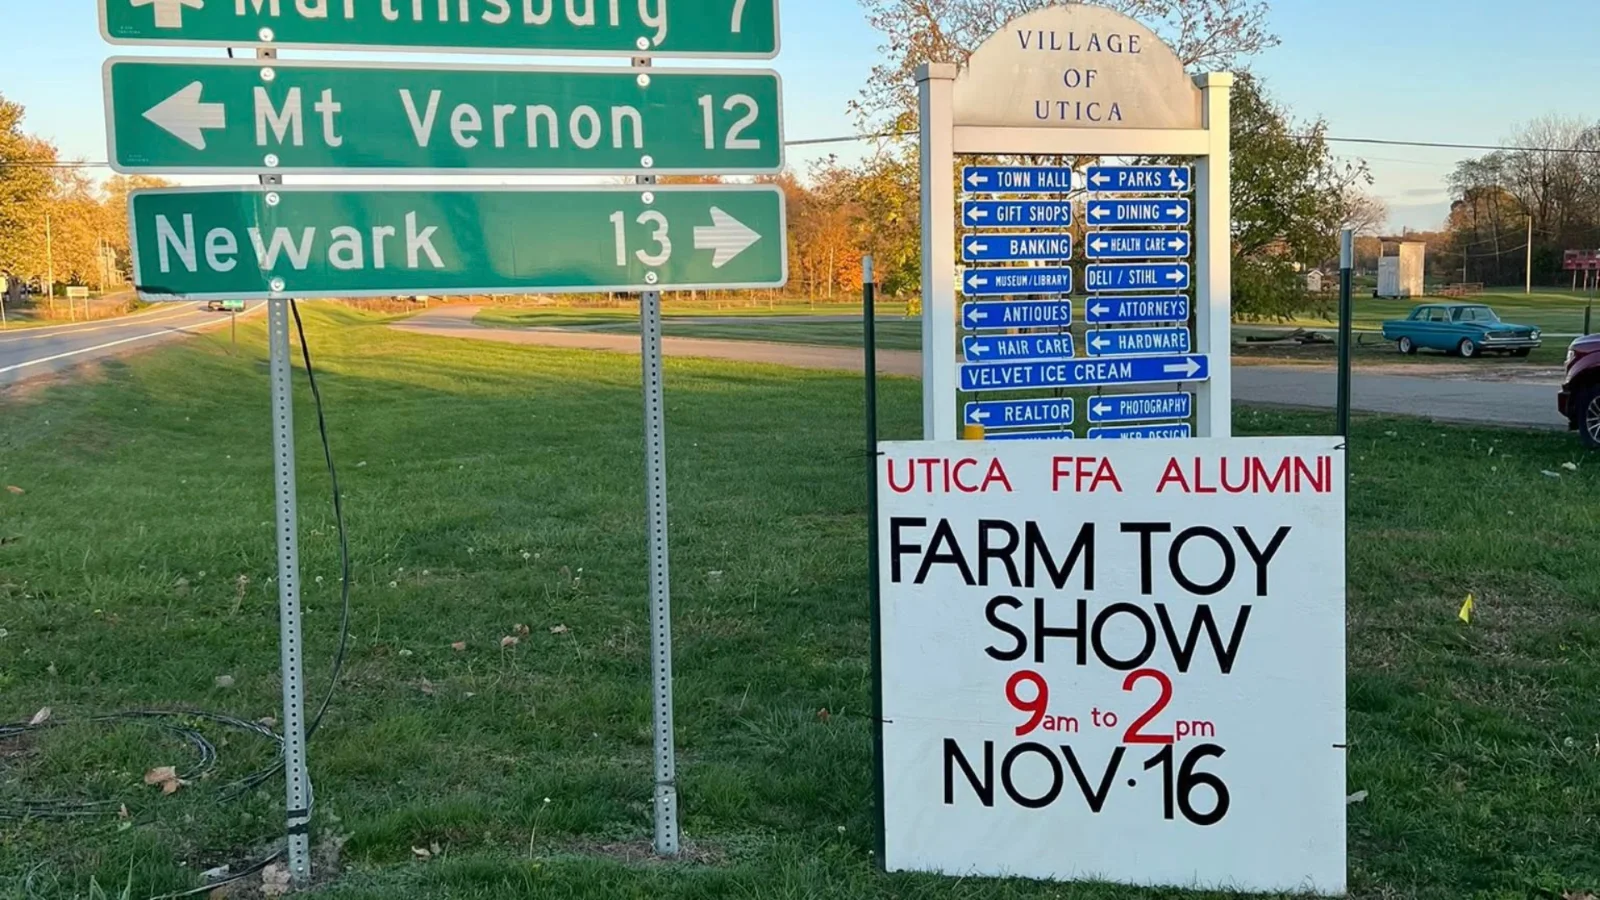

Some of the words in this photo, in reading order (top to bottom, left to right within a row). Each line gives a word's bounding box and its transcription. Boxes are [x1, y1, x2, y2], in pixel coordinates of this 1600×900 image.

[1017, 30, 1141, 53] VILLAGE
[1063, 68, 1098, 88] OF
[253, 86, 343, 147] Mt
[398, 88, 644, 148] Vernon
[697, 93, 761, 151] 12
[1035, 100, 1122, 121] UTICA
[997, 171, 1031, 187] TOWN
[1038, 171, 1069, 187] HALL
[1118, 171, 1162, 187] PARKS
[996, 206, 1022, 222] GIFT
[1029, 205, 1069, 221] SHOPS
[1117, 204, 1160, 220] DINING
[155, 210, 445, 273] Newark
[608, 210, 673, 268] 13
[1010, 239, 1068, 255] BANKING
[1110, 238, 1142, 252] HEALTH
[1145, 237, 1166, 251] CARE
[995, 274, 1068, 288] MUSEUM/LIBRARY
[1089, 270, 1112, 286] DELI
[1129, 269, 1158, 285] STIHL
[1003, 305, 1068, 322] ANTIQUES
[1118, 300, 1186, 317] ATTORNEYS
[998, 340, 1029, 356] HAIR
[1036, 338, 1071, 354] CARE
[1118, 332, 1187, 349] HARDWARE
[968, 366, 1033, 385] VELVET
[1040, 365, 1067, 382] ICE
[1074, 362, 1132, 380] CREAM
[1005, 404, 1070, 421] REALTOR
[1120, 398, 1187, 415] PHOTOGRAPHY
[886, 456, 1013, 493] UTICA
[1051, 456, 1122, 493] FFA
[1156, 456, 1332, 493] ALUMNI
[890, 517, 1095, 591] FARM
[1120, 522, 1292, 597] TOY
[984, 595, 1252, 674] SHOW
[1091, 707, 1118, 727] to
